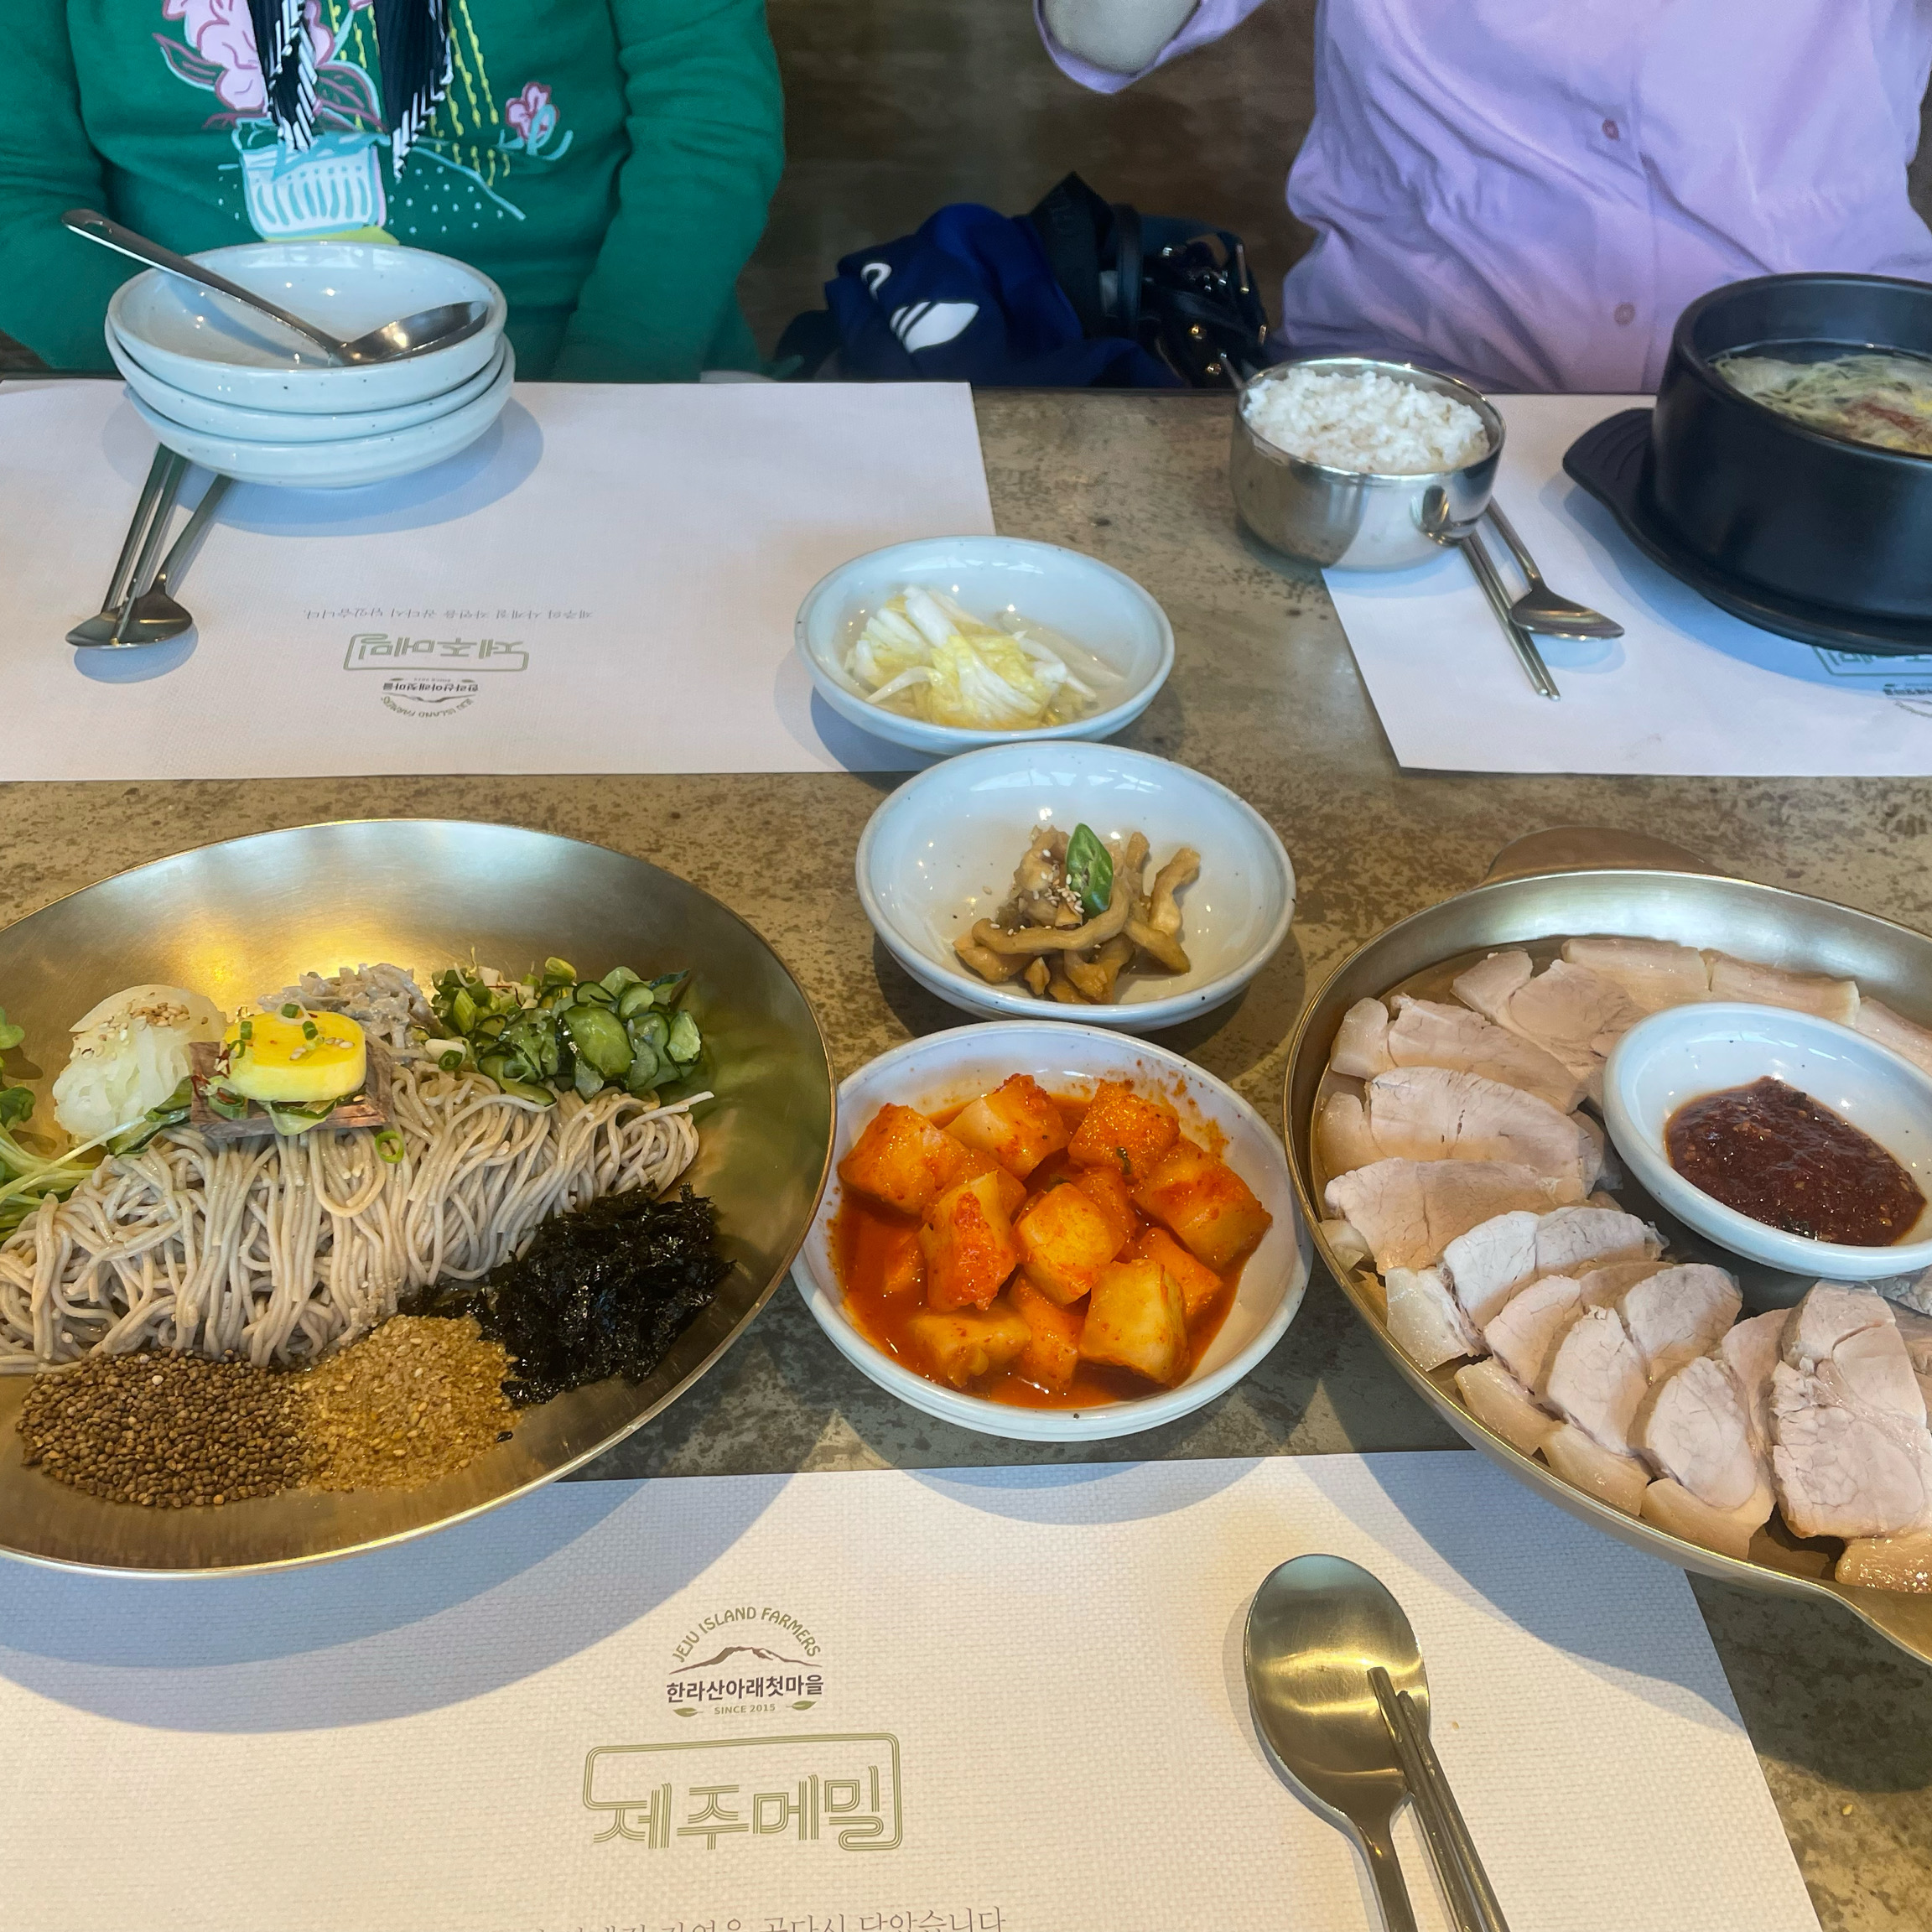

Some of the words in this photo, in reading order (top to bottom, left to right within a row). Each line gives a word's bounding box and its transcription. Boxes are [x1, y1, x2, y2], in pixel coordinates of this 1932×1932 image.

[342, 633, 530, 662] 제주메밀
[672, 1630, 700, 1663] JEJU
[698, 1606, 757, 1634] ISLAND
[761, 1607, 821, 1657] FARMERS
[666, 1674, 824, 1703] 한라산아래첫마을
[714, 1705, 747, 1715] SINCE
[749, 1703, 776, 1713] 2015
[583, 1763, 903, 1852] 제주메밀
